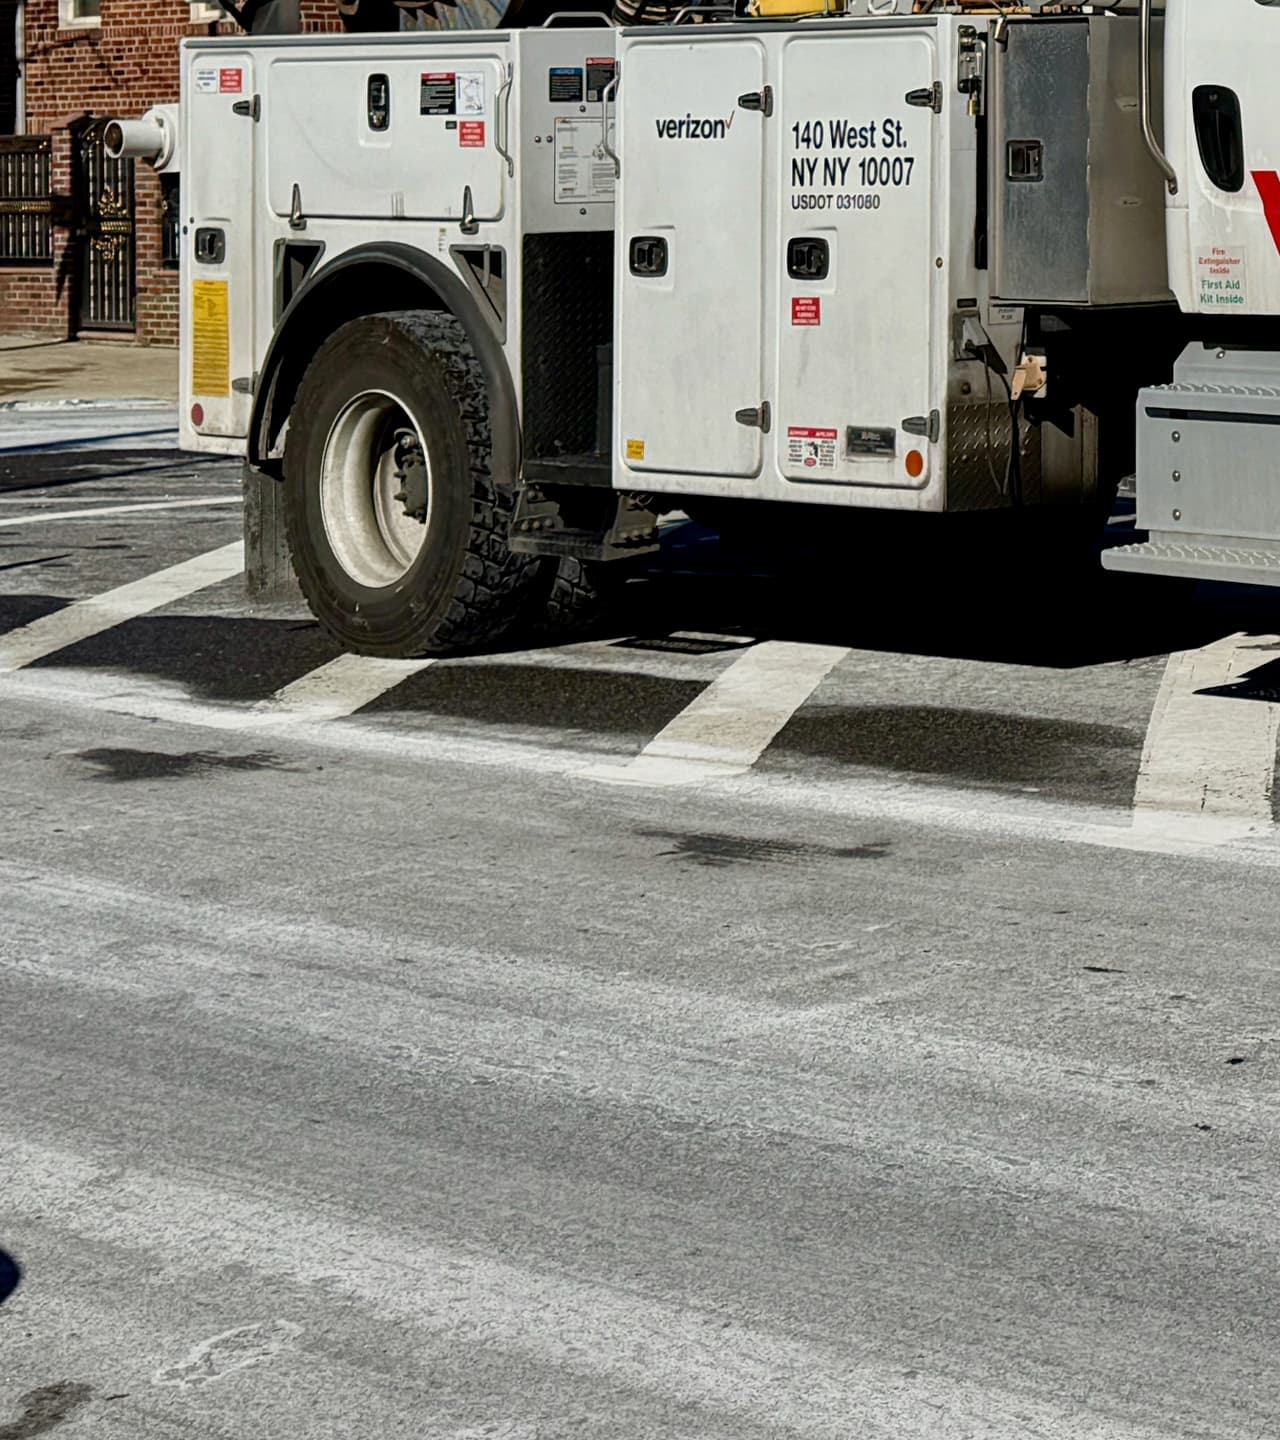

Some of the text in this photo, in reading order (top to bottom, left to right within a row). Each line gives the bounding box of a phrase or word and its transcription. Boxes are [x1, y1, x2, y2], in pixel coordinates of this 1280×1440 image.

[656, 112, 725, 139] verizon
[792, 118, 907, 149] 140 West St.
[791, 156, 915, 186] NY NY 10007
[791, 194, 881, 210] USDOT 031080
[1201, 279, 1241, 290] First Aid
[1200, 293, 1244, 304] Kit Inside
